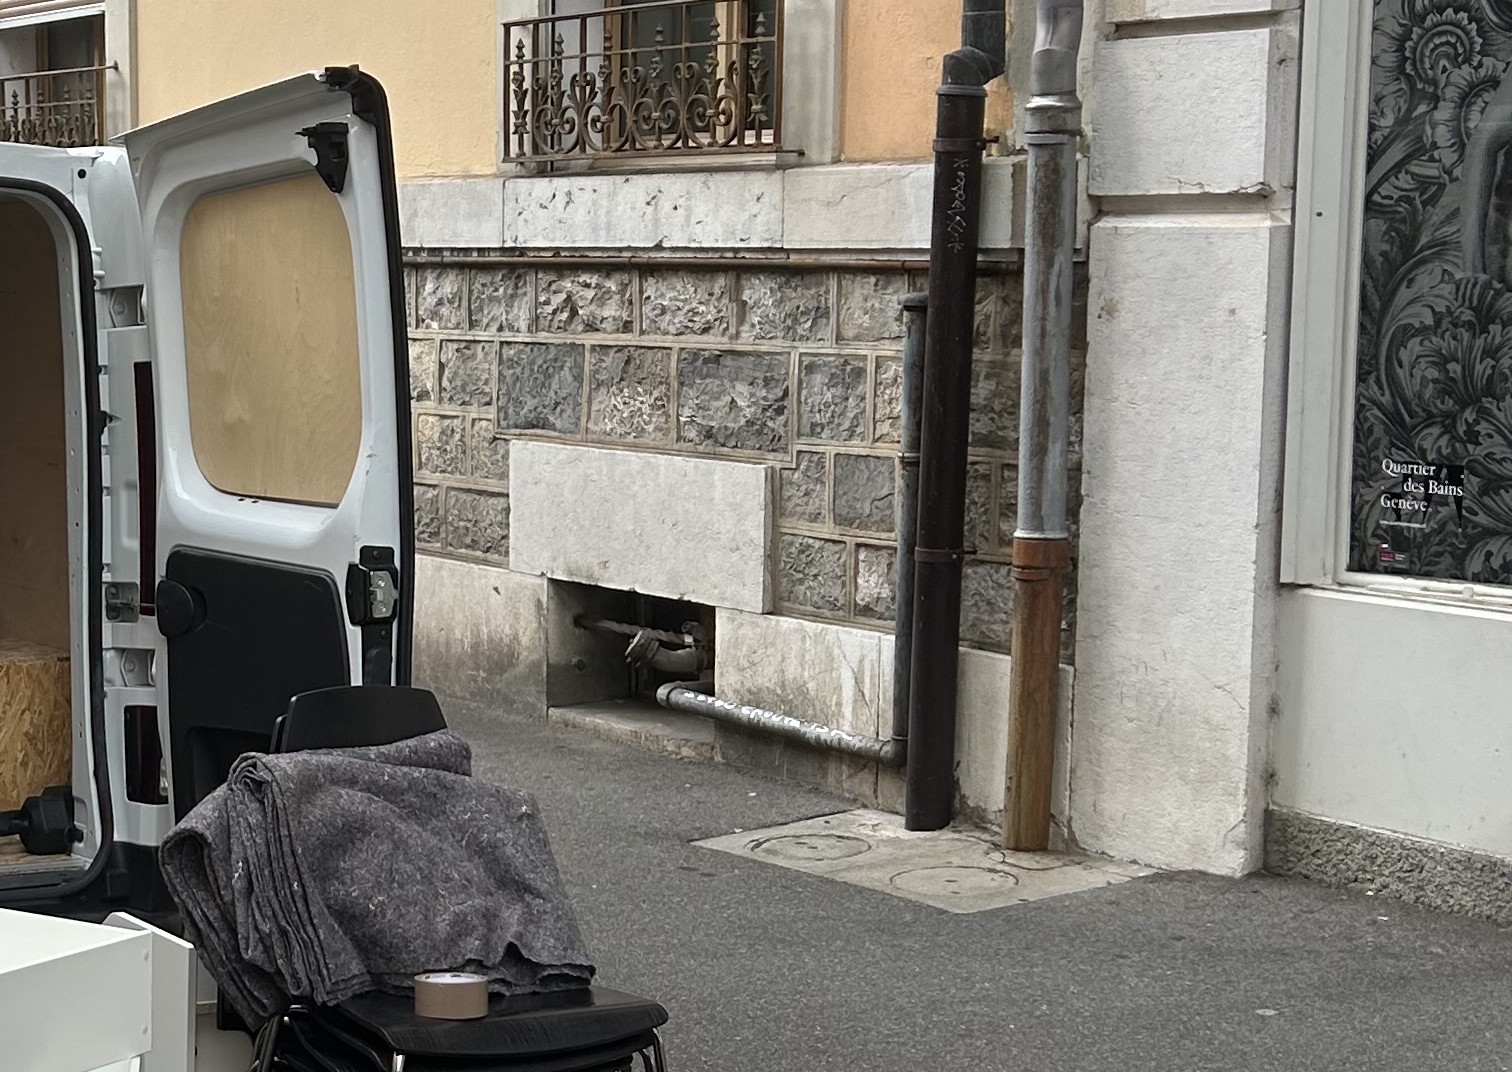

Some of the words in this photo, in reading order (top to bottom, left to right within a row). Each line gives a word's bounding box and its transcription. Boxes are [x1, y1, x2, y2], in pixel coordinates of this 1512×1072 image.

[1382, 458, 1437, 477] Quartier
[1403, 477, 1425, 493] des
[1428, 479, 1464, 496] Bains
[1380, 493, 1428, 511] Genève
